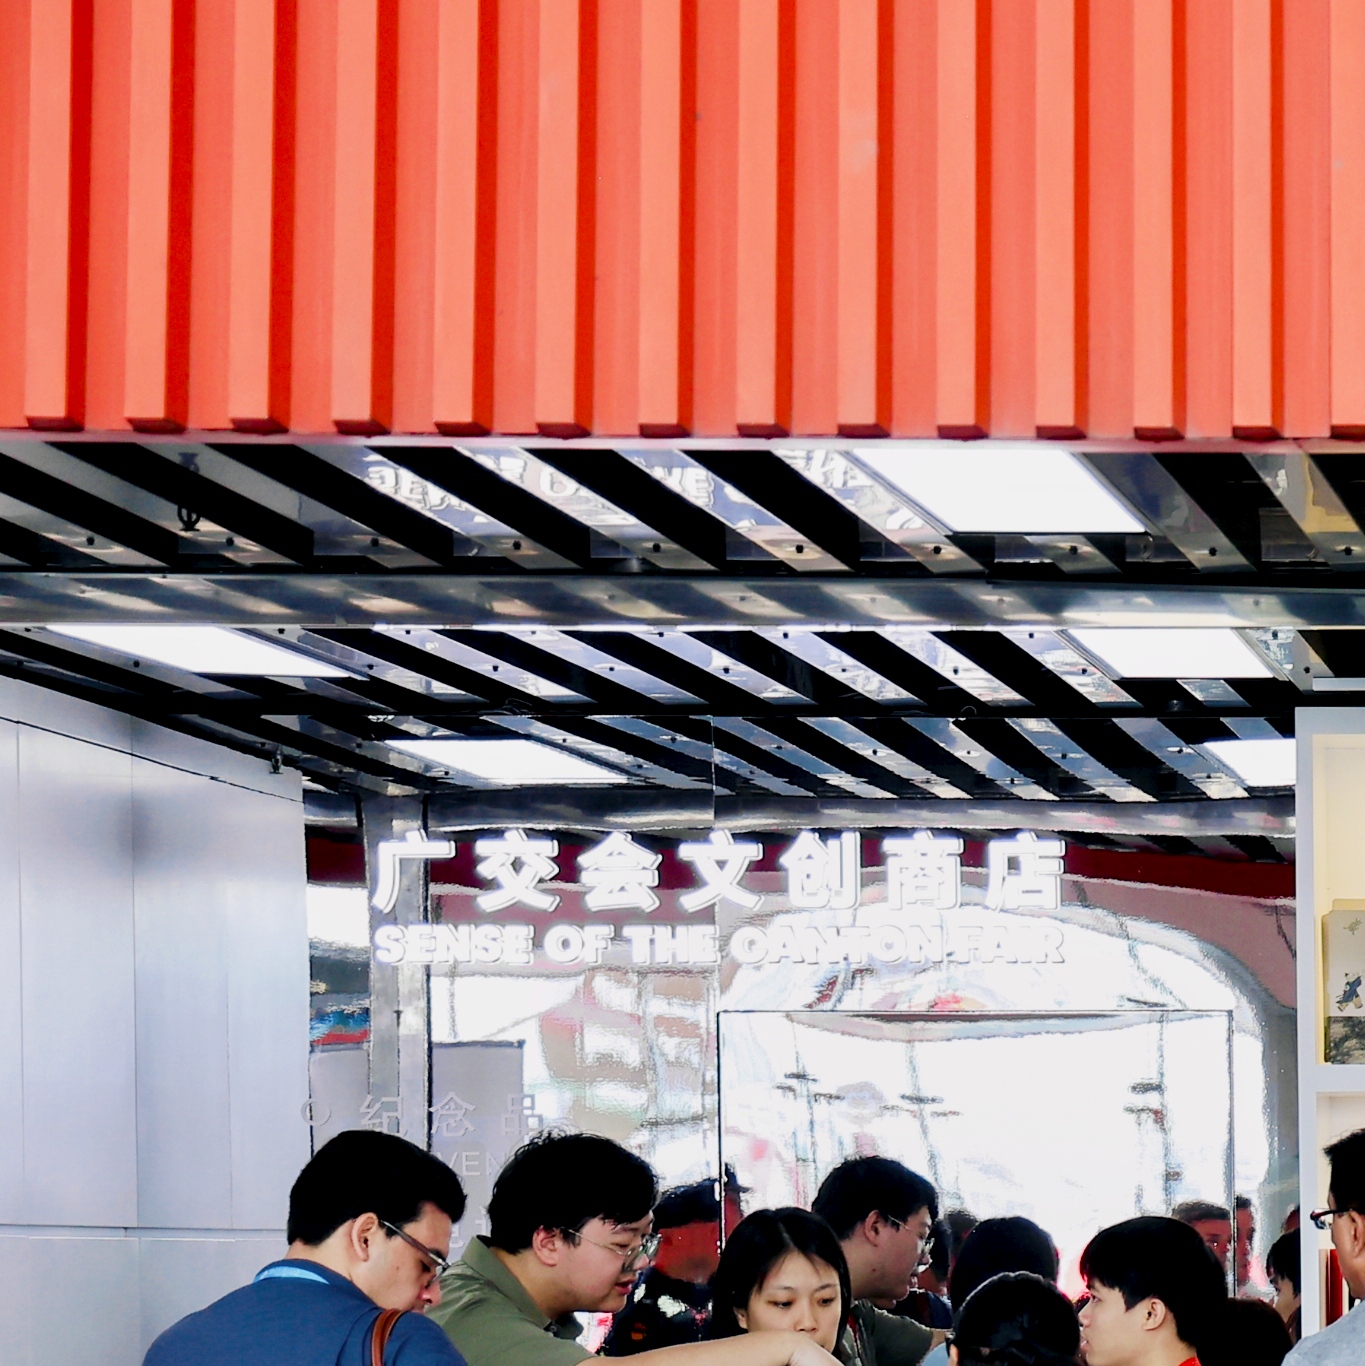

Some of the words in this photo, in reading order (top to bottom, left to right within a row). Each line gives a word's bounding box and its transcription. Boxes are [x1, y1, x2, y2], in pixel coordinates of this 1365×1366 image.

[372, 829, 1067, 912] 广交会文创商店
[372, 924, 535, 965] SENSE
[543, 924, 618, 965] OF
[627, 924, 721, 965] THE
[729, 924, 951, 965] CANTON
[955, 924, 1066, 965] FAIR
[359, 1091, 545, 1140] 纪念品
